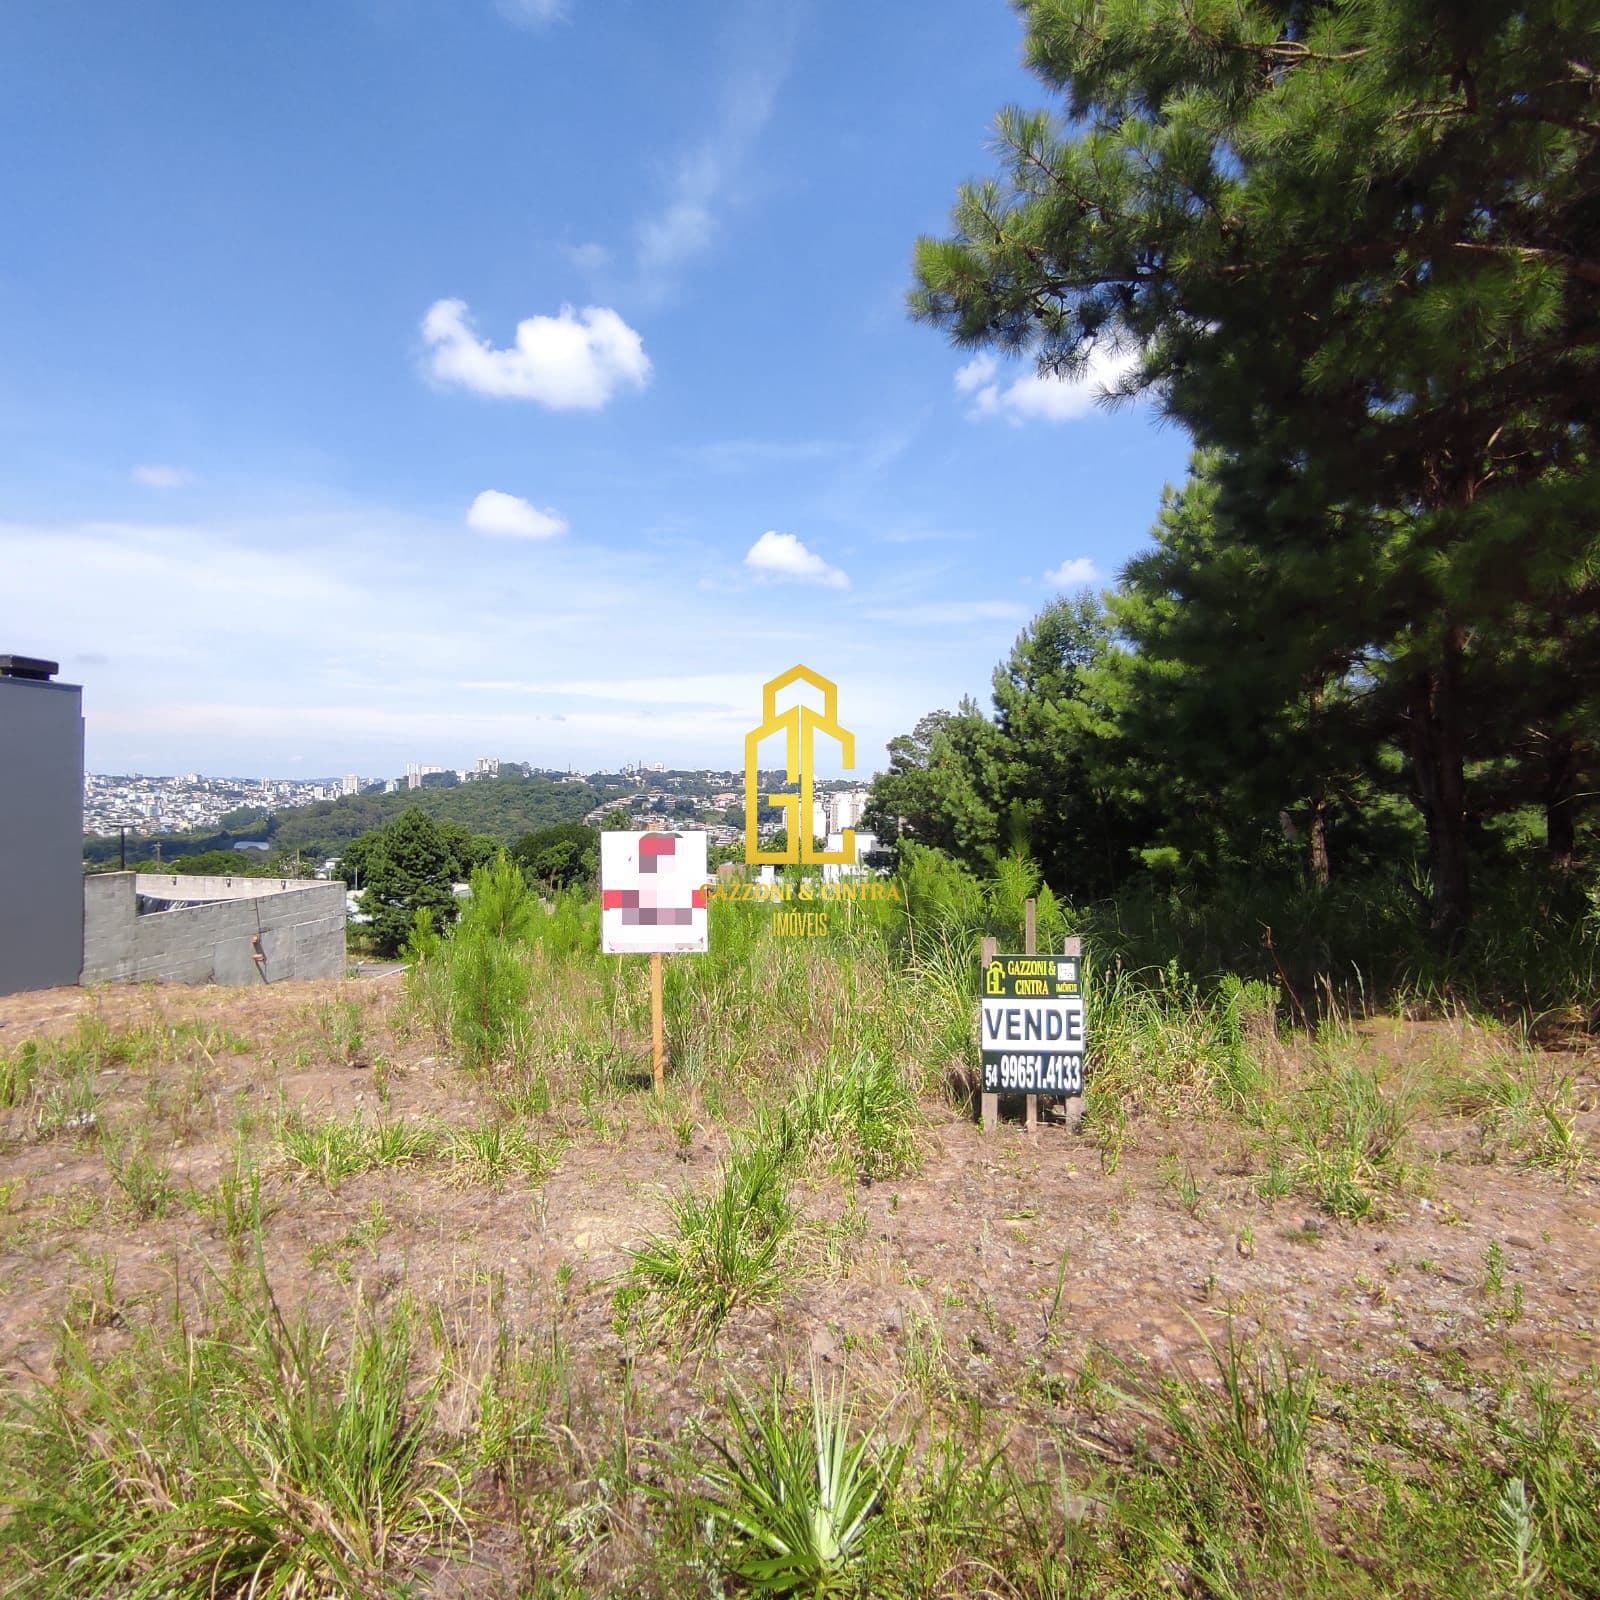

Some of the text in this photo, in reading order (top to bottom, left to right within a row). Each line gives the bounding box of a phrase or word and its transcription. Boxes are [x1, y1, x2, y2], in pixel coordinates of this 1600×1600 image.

[1007, 960, 1057, 976] GAZZONI &
[1014, 980, 1049, 995] CINTRA
[984, 1008, 1081, 1041] VENDE
[985, 1054, 1081, 1090] 54 99651.4133
